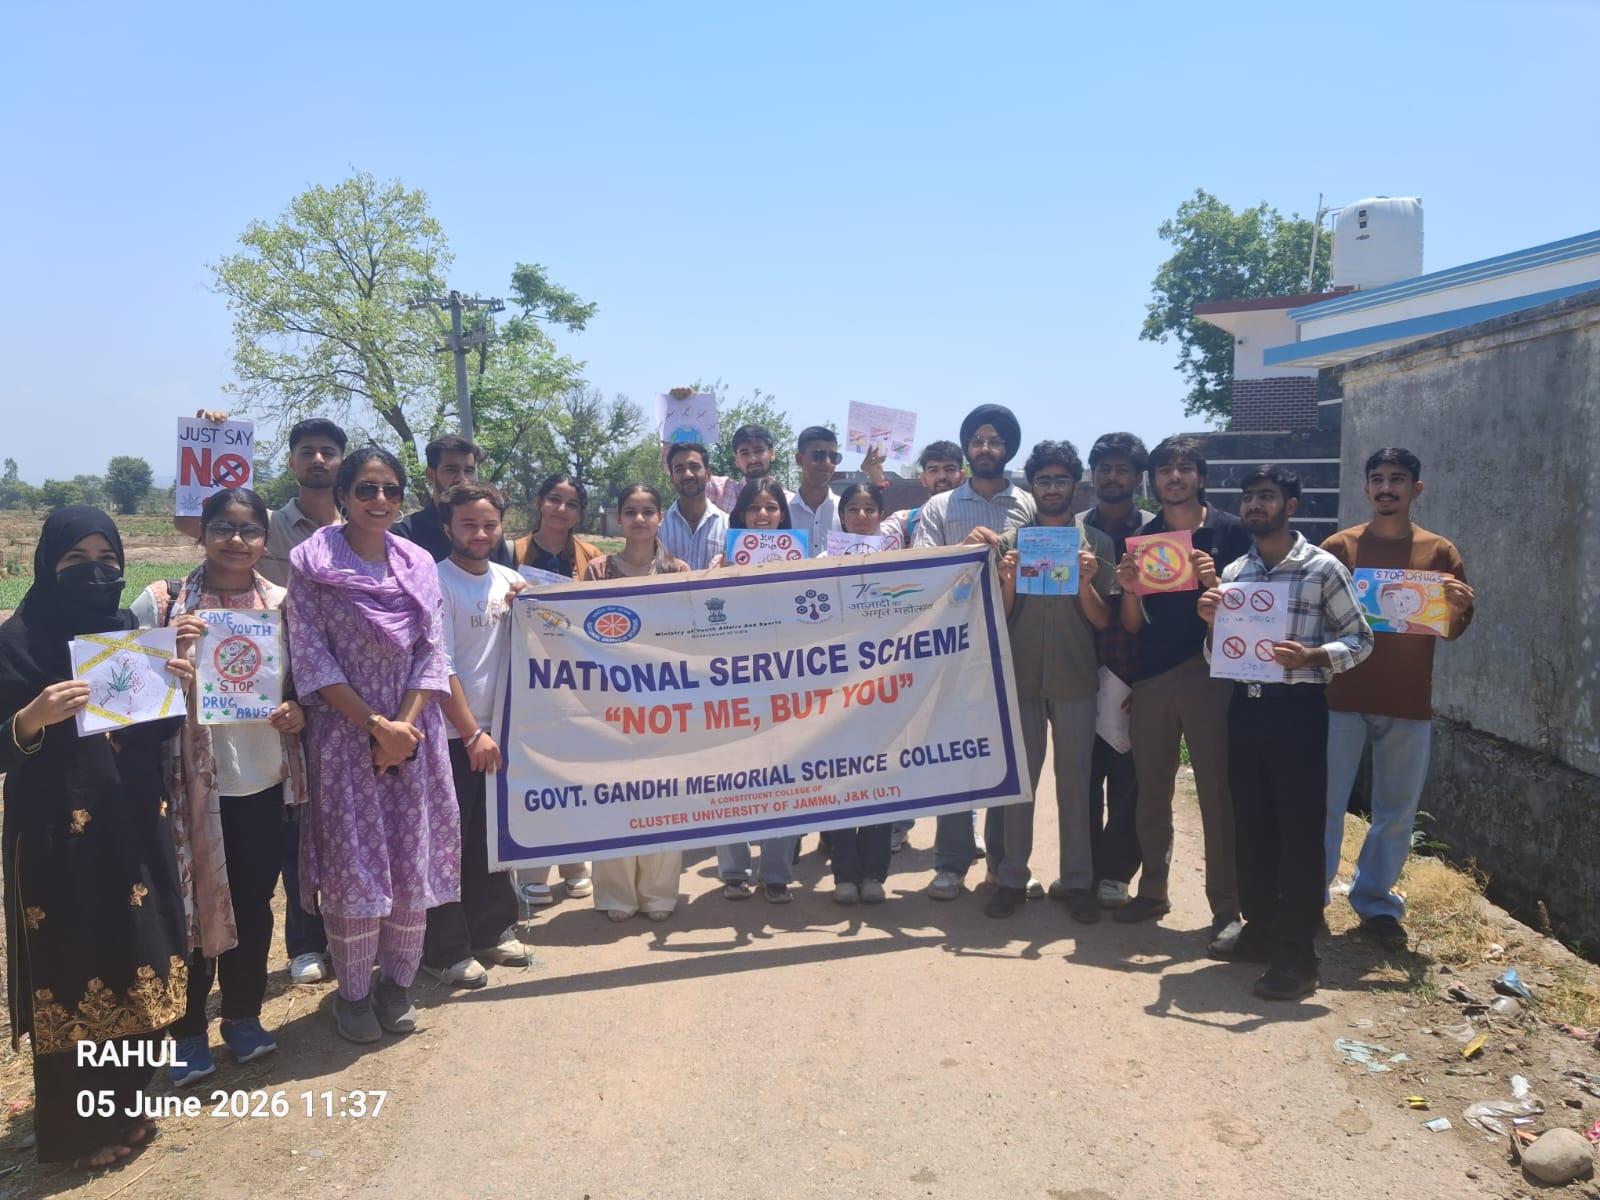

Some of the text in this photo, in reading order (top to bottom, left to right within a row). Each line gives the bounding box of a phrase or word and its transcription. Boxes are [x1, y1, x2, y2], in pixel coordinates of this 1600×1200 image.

[180, 426, 253, 446] JUST SAY
[181, 446, 250, 488] NO
[1376, 571, 1405, 580] STOP
[199, 612, 233, 624] SAVE
[227, 624, 272, 636] YOUTH
[529, 622, 970, 693] NATIONAL SERVICE SCHEME
[202, 696, 238, 709] DRUG
[605, 673, 913, 734] “NOT ME, BUT YOU”
[524, 737, 991, 812] GOVT. GANDHI MEMORIAL SCIENCE COLLEGE
[718, 791, 773, 805] CONSTITUENT
[775, 786, 810, 799] COLLEGE
[812, 785, 823, 793] OF
[629, 785, 902, 830] CLUSTER UNIVERSITY OF JAMMU, J&K (U.T)
